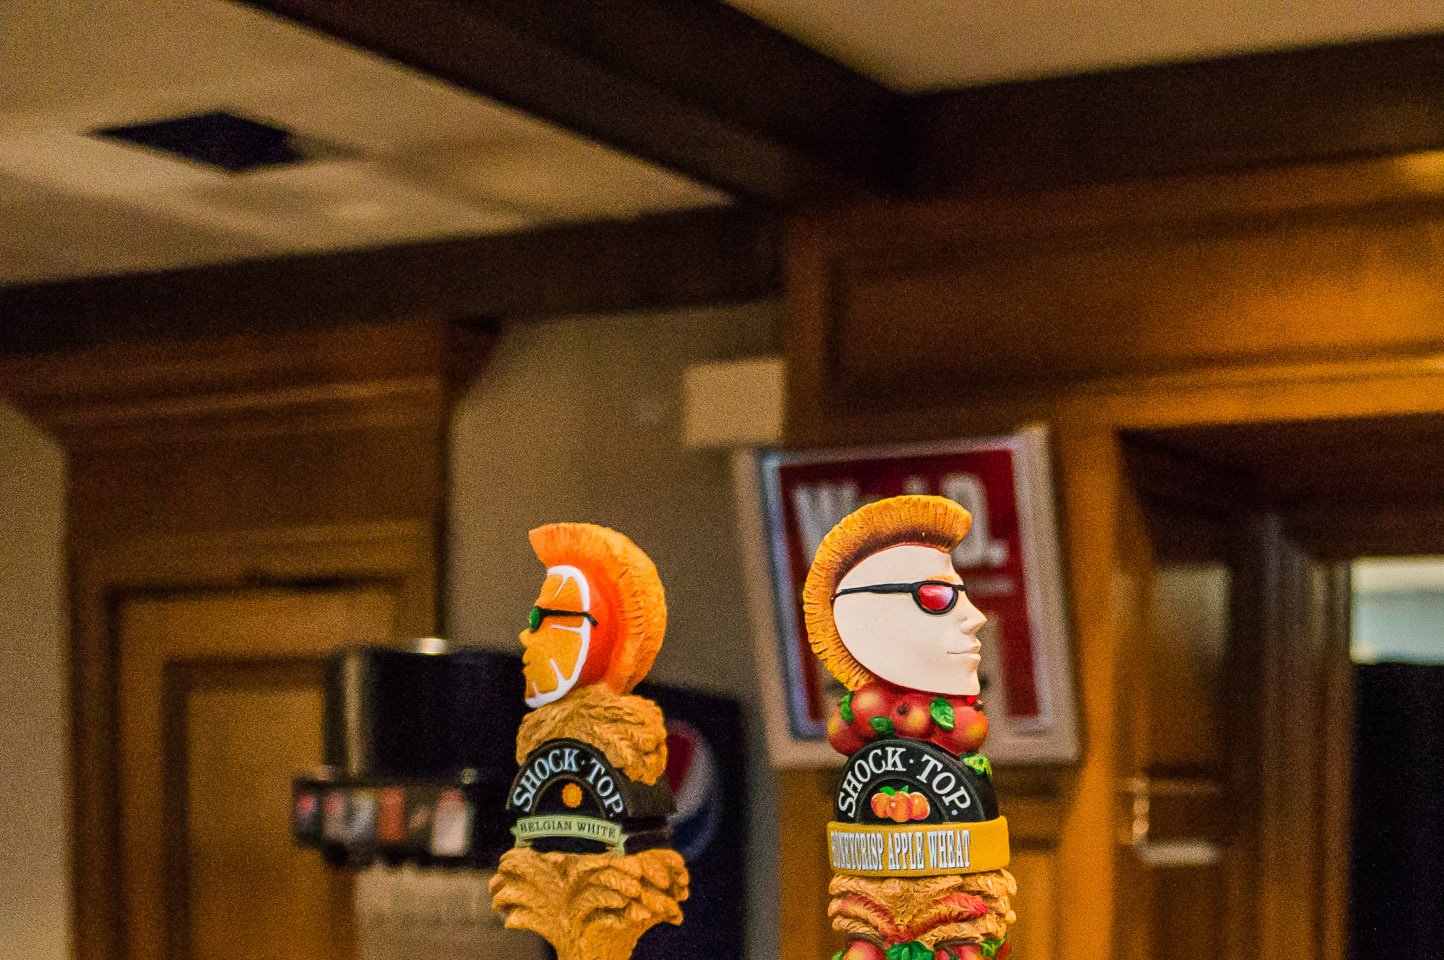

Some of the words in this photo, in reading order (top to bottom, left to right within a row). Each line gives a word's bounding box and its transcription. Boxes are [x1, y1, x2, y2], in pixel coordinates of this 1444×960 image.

[513, 748, 579, 812] SHOCK
[838, 747, 907, 818] SHOCK
[520, 820, 572, 833] BELGIAN
[576, 822, 616, 838] WHITE
[888, 832, 925, 871] APPLE
[927, 830, 971, 869] WHEAT
